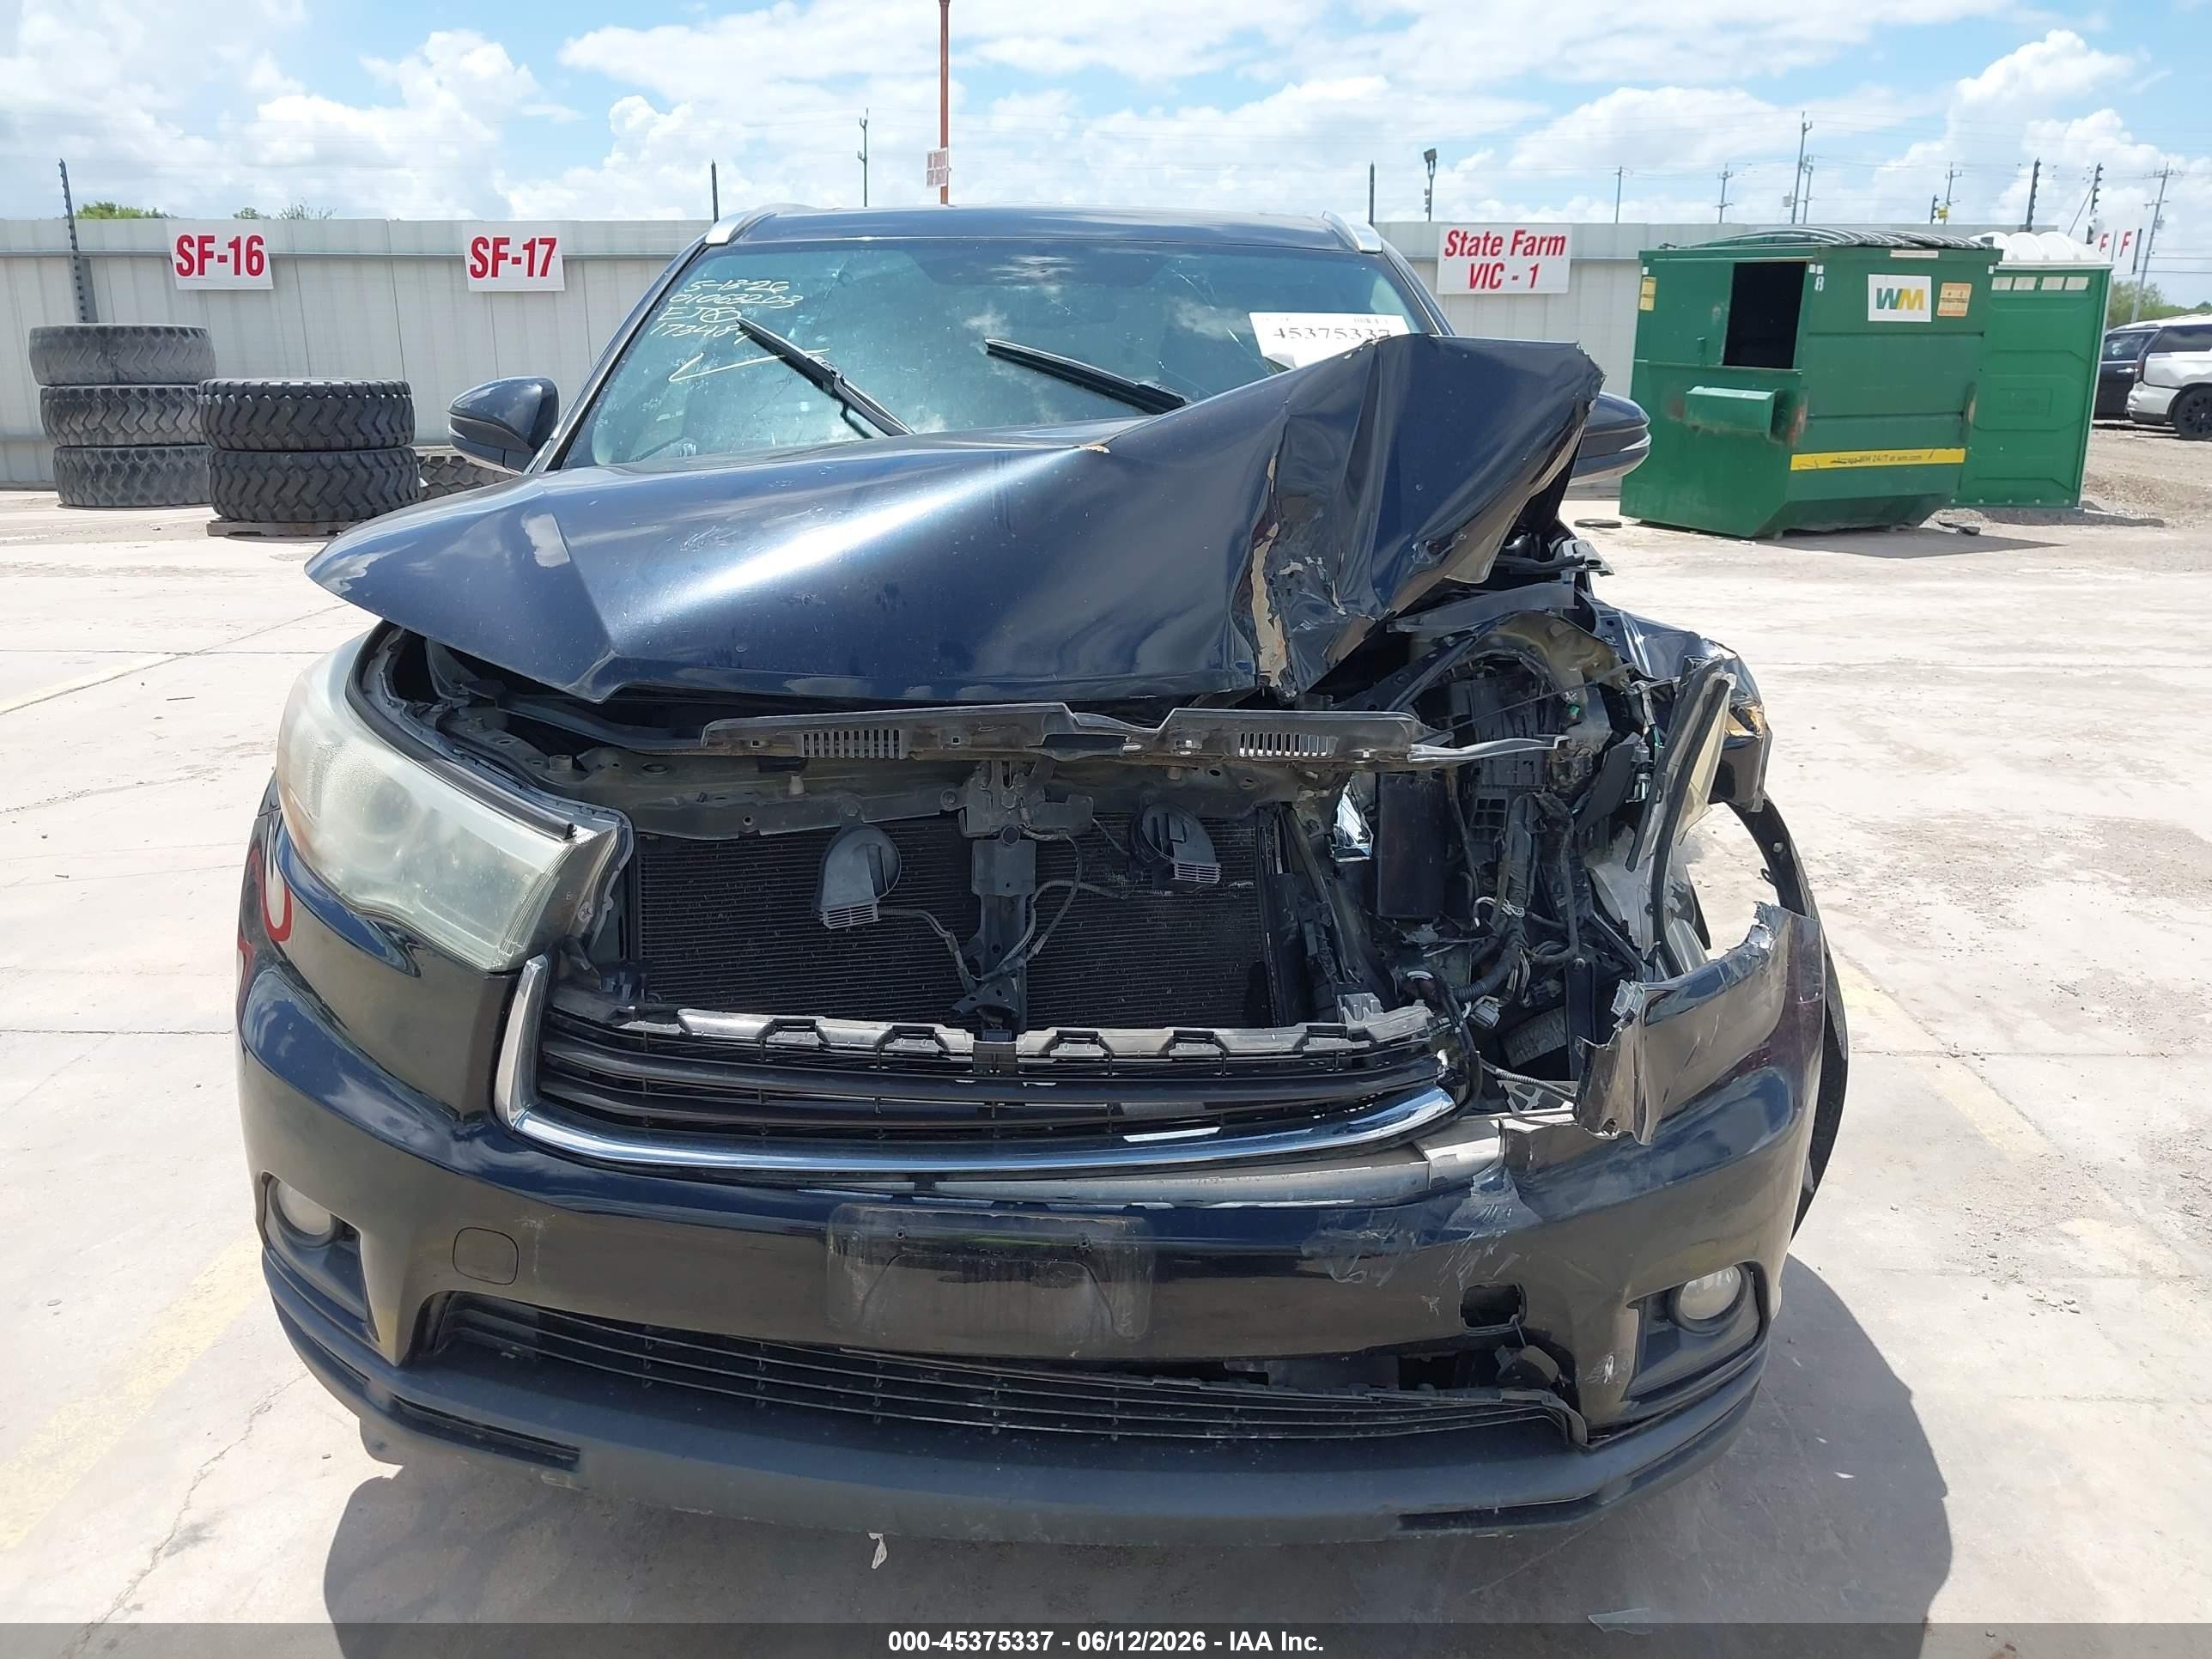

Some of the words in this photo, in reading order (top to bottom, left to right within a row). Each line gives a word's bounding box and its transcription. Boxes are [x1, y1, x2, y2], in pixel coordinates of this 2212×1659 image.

[175, 234, 265, 277] SF-16
[1445, 229, 1504, 258] State
[1510, 229, 1566, 257] Farm
[2119, 231, 2133, 258] F
[469, 236, 557, 280] SF-17
[1469, 262, 1505, 289] VIC
[1530, 264, 1540, 289] 1
[1875, 288, 1924, 310] WM
